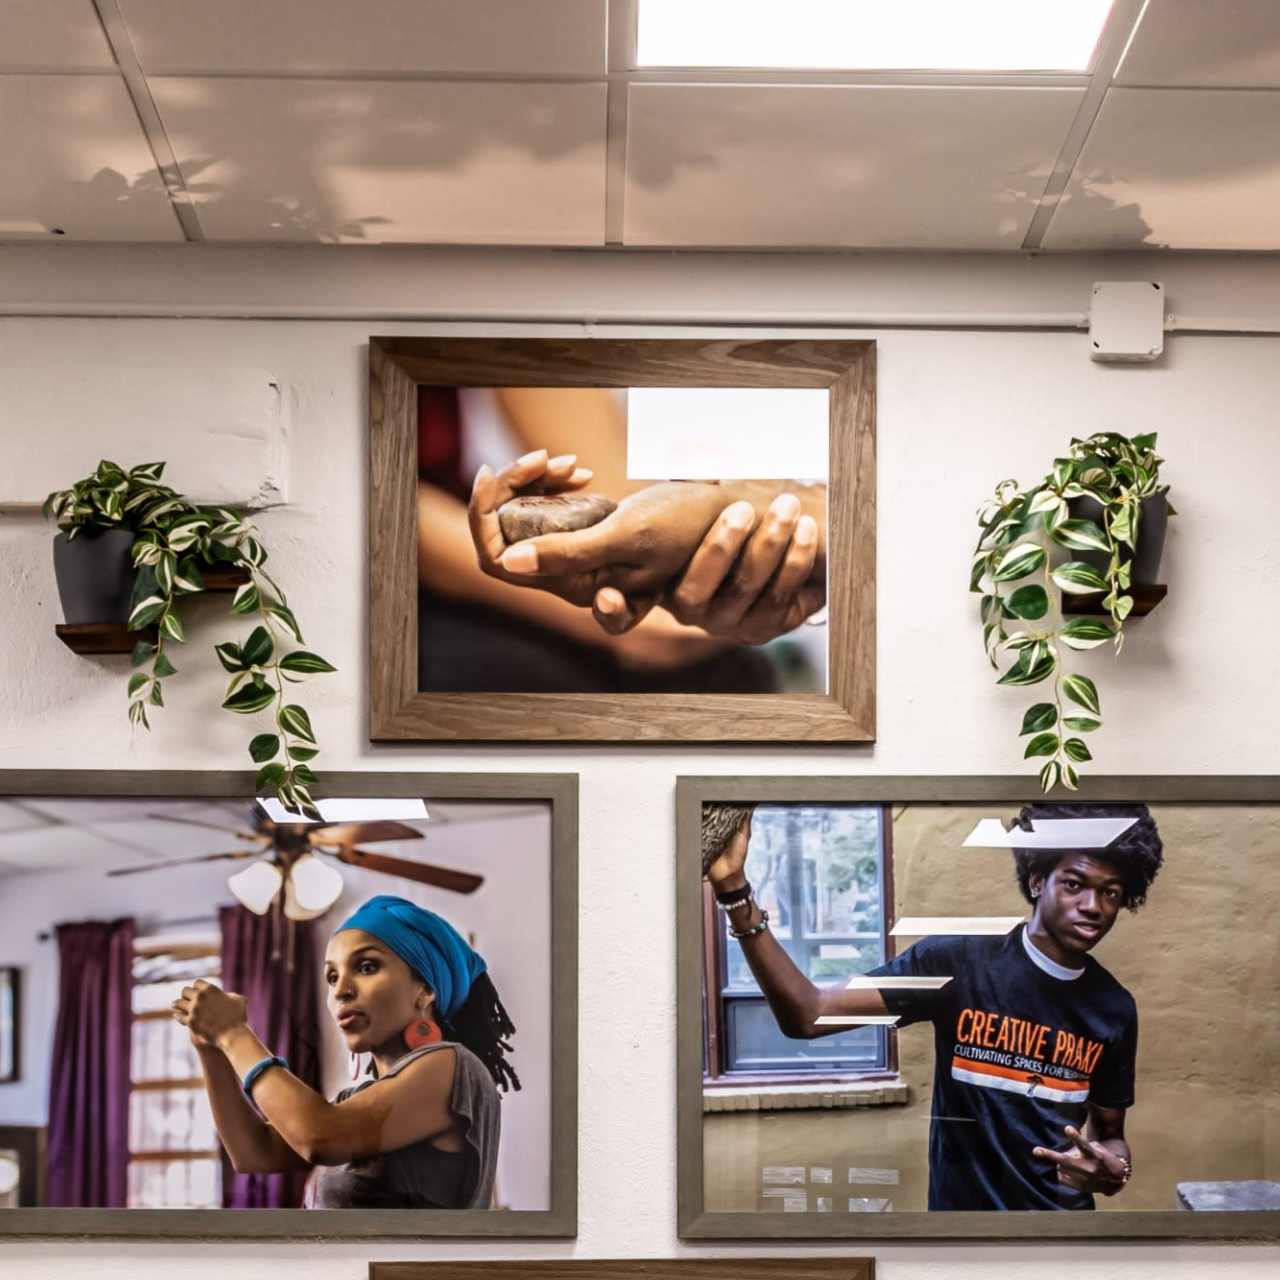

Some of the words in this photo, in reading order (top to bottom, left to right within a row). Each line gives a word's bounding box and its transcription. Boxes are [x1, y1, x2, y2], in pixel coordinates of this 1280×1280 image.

[956, 1008, 1052, 1060] CREATIVE
[953, 1044, 1013, 1067] CULTIVATING
[1013, 1056, 1042, 1073] SPACES
[1043, 1063, 1064, 1079] FOR
